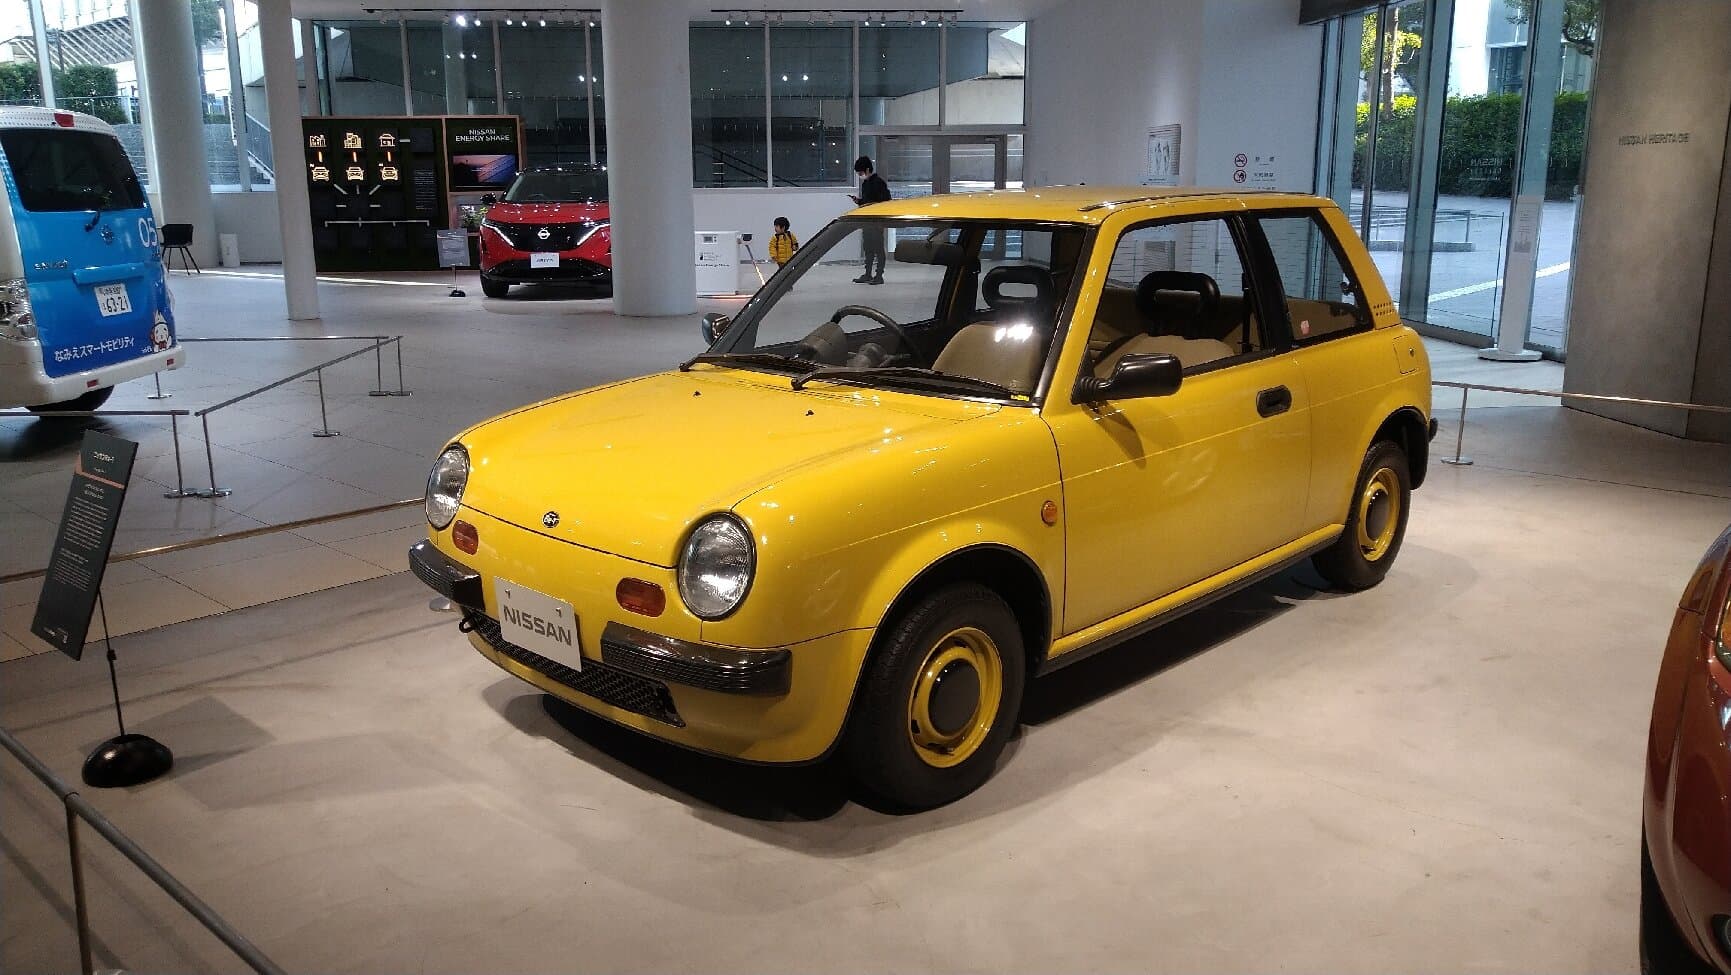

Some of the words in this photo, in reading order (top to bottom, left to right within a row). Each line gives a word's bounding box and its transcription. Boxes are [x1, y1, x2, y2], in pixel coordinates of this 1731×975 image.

[485, 134, 510, 142] SHARE
[1618, 135, 1646, 146] NISSAN
[138, 217, 158, 248] 05
[54, 336, 135, 362] なみえスマートモビリティ
[503, 605, 572, 646] NISSAN
